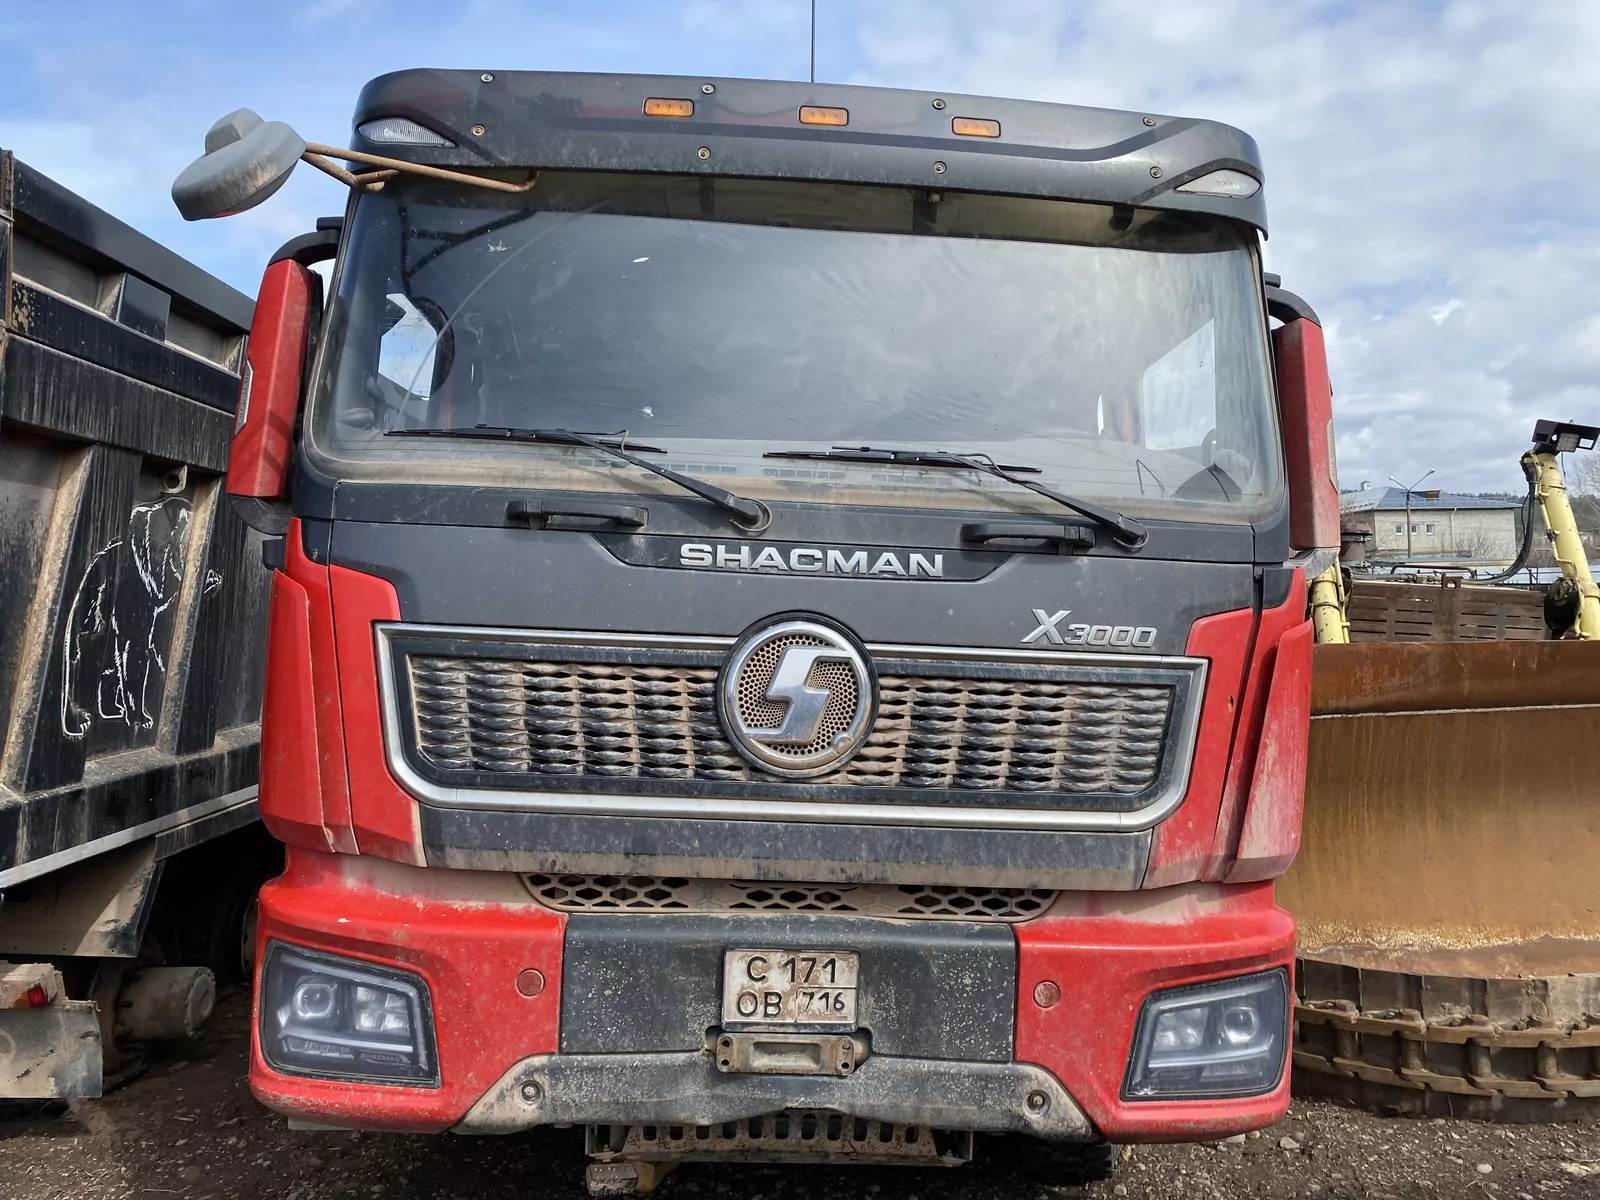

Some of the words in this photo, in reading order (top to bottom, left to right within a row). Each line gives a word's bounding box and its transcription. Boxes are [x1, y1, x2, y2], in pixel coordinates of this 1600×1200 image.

[680, 543, 943, 577] SHACMAN
[1020, 608, 1157, 647] X3000
[782, 957, 836, 983] 171
[802, 991, 845, 1012] 716
